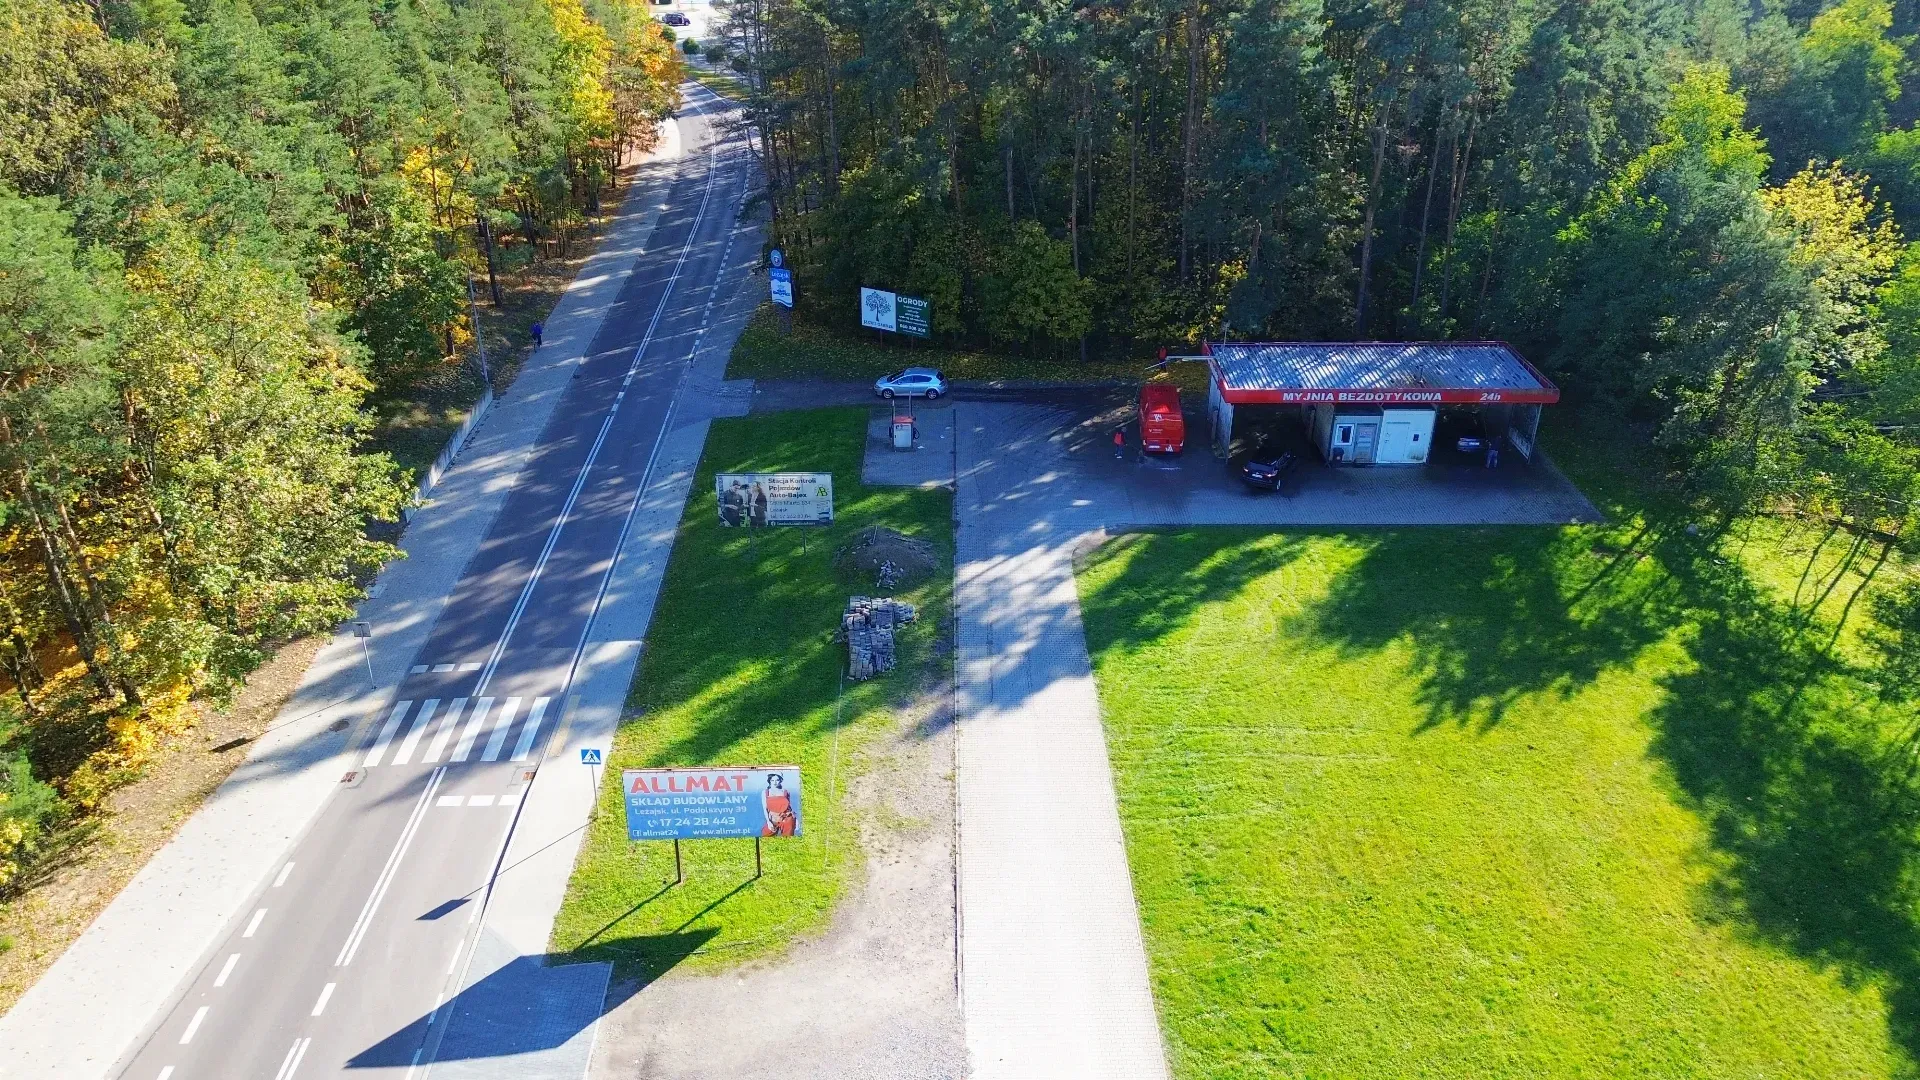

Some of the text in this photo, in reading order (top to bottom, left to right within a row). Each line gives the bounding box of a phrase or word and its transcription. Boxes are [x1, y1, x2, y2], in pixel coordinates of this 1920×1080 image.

[897, 296, 928, 308] OGRODY
[1282, 392, 1442, 401] MYJNIA BEZDOTYKOWA
[1480, 392, 1501, 401] 24h
[630, 775, 748, 793] ALLMAT
[631, 795, 749, 806] SKŁAD BUDOWLANY
[660, 816, 736, 827] 17 24 28 443
[642, 827, 751, 837] allmat24 www.allmat.pl
